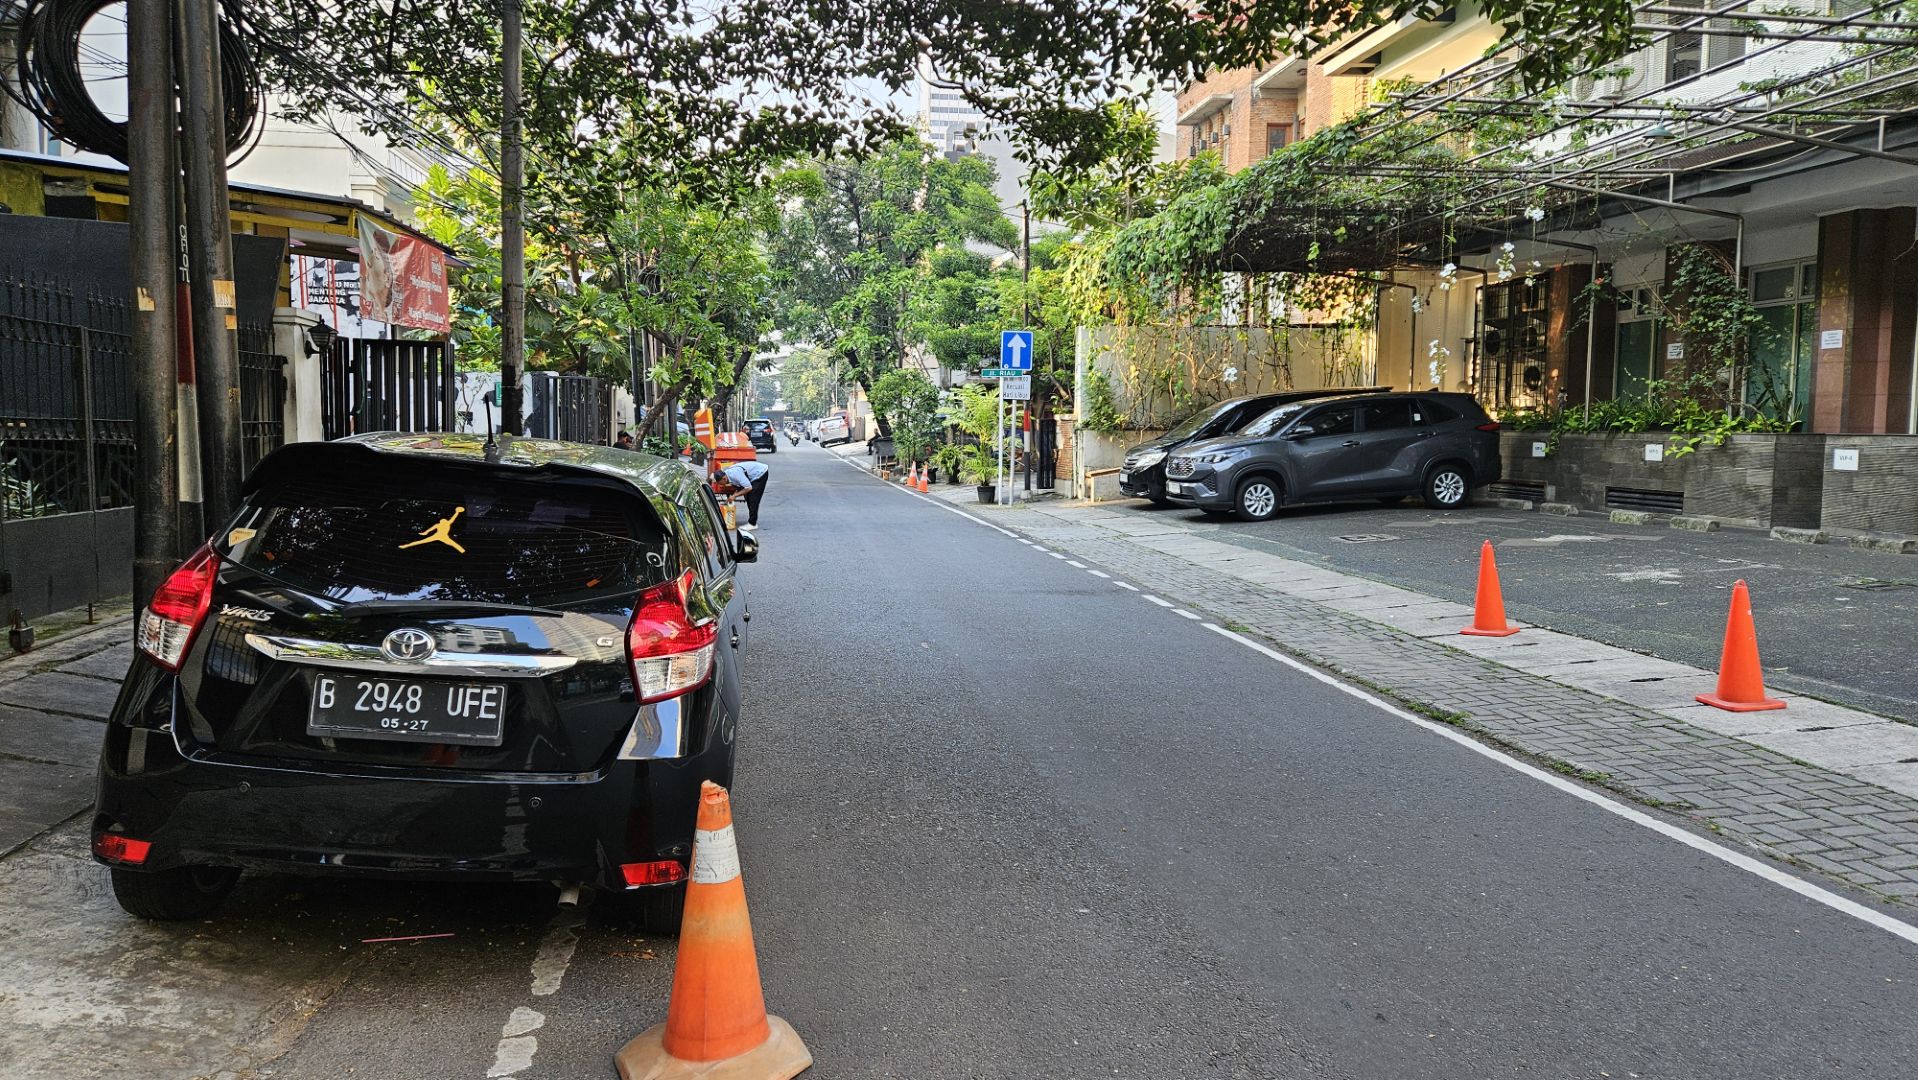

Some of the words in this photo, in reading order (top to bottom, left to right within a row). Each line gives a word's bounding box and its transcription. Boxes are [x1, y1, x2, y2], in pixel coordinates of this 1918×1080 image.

[219, 603, 275, 621] YARIS
[596, 637, 614, 647] G
[318, 678, 336, 709] B
[354, 681, 423, 714] 2948
[446, 686, 498, 719] UFE
